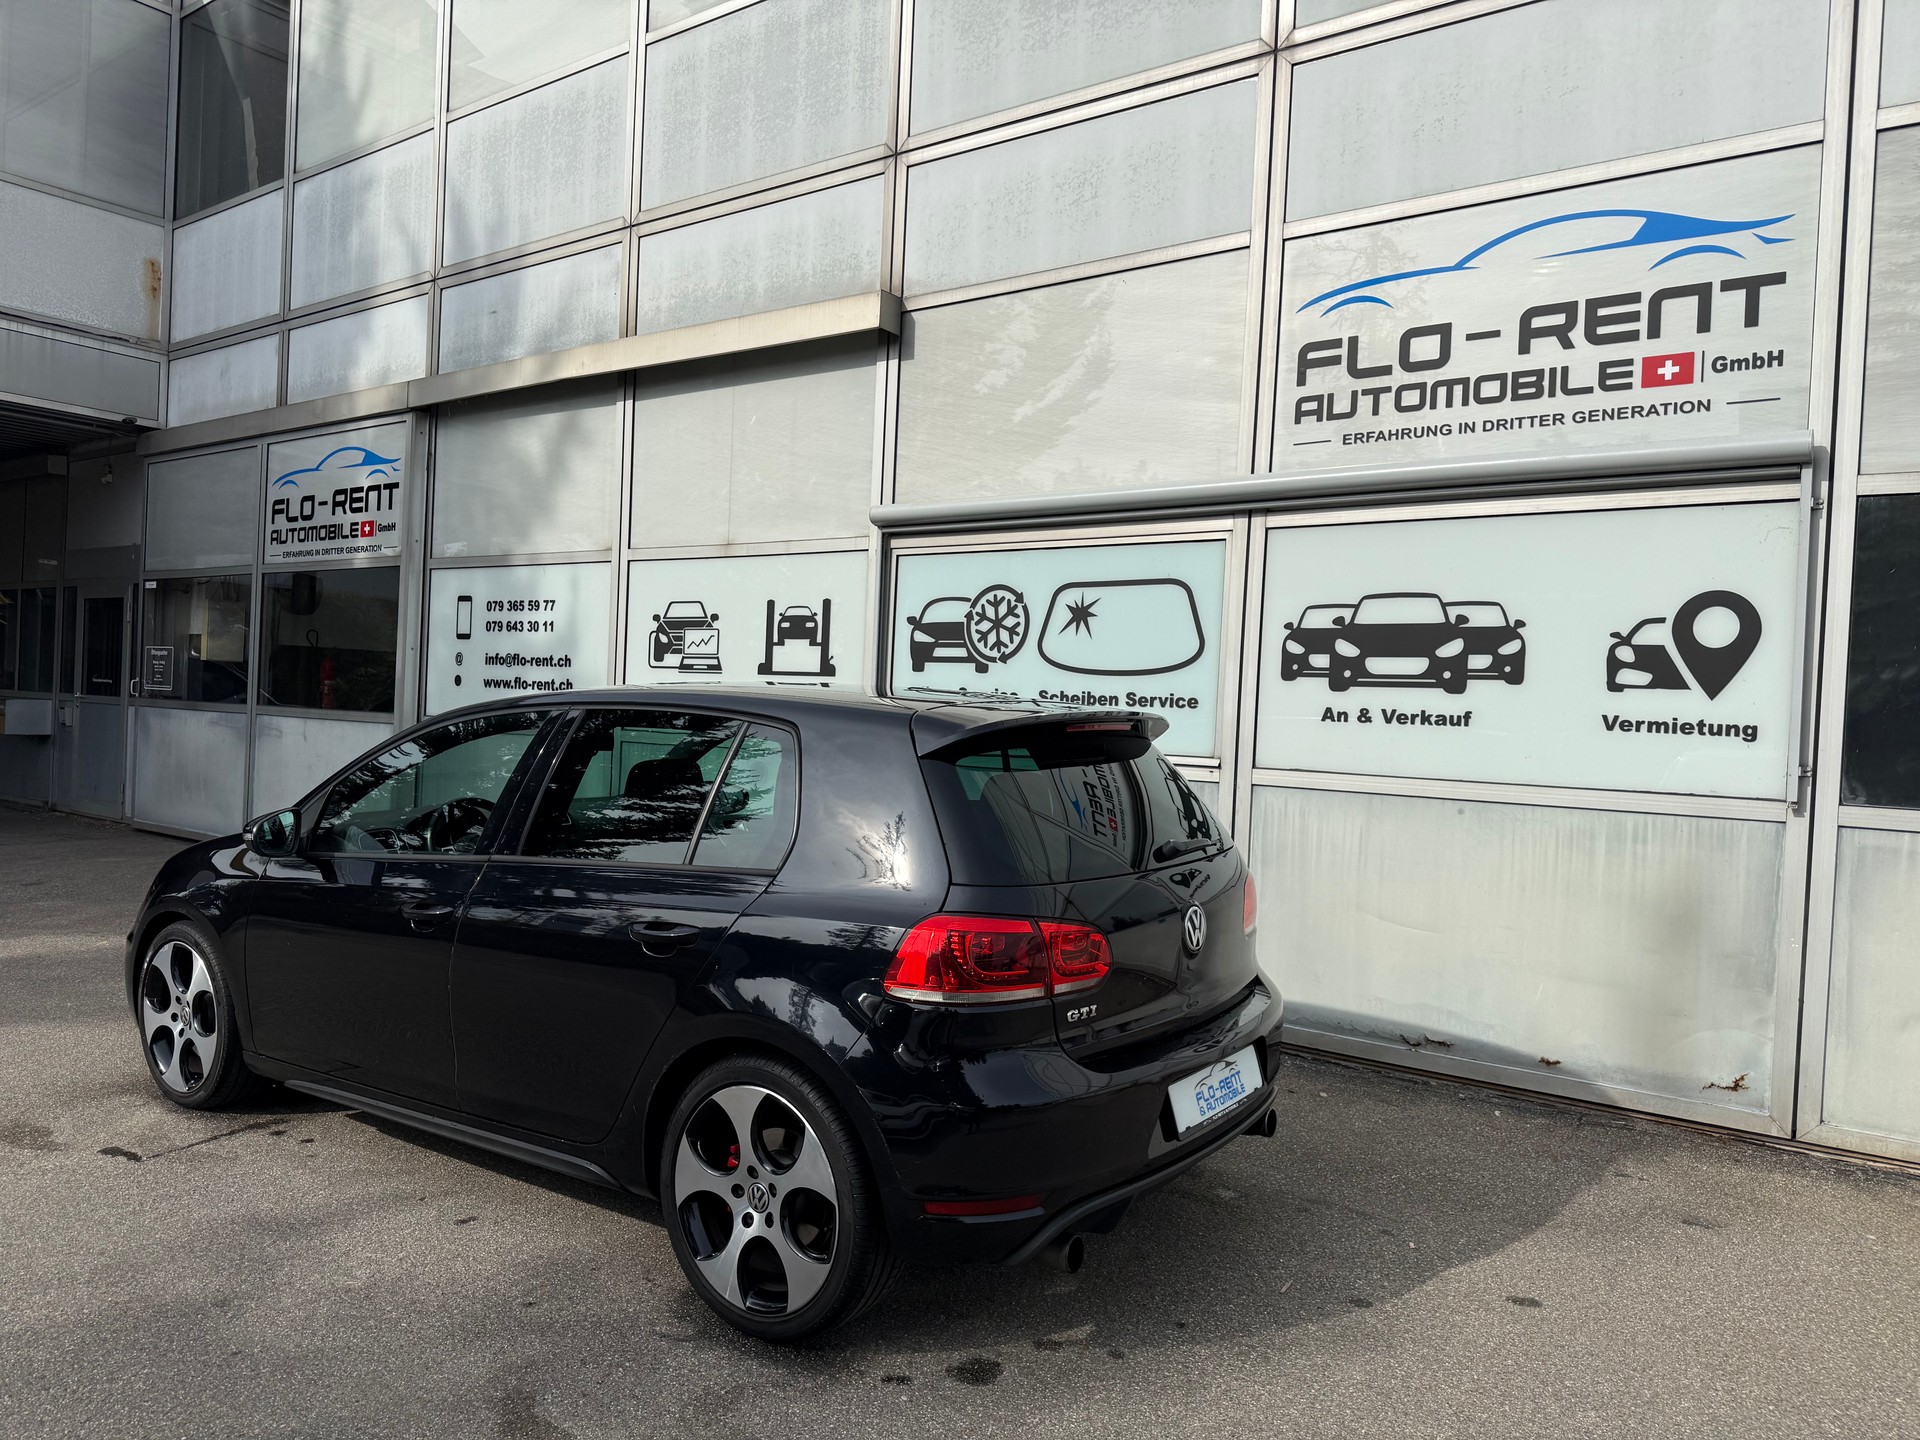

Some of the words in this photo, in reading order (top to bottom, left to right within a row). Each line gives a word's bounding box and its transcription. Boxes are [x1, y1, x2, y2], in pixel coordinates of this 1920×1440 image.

[1294, 358, 1634, 425] AUTOMOBILE
[1710, 349, 1784, 374] GmbH
[1341, 422, 1453, 446] ERFAHRUNG
[1458, 420, 1476, 435] IN
[1481, 412, 1566, 433] DRITTER
[1571, 398, 1712, 424] GENERATION
[270, 521, 360, 546] AUTOMOBILE
[377, 522, 396, 533] GmbH
[282, 549, 314, 558] ERFAHRUNG
[315, 548, 320, 557] IN
[321, 546, 344, 556] DRITTER
[345, 544, 382, 554] GENERATION
[486, 600, 504, 612] 079
[506, 600, 525, 612] 365
[527, 599, 540, 612] 59
[543, 599, 556, 612] 77
[485, 621, 503, 632] 079
[506, 621, 524, 632] 643
[527, 620, 540, 632] 30
[542, 620, 554, 632] 11
[484, 653, 571, 668] info@flo-rent.ch
[483, 676, 573, 691] www.flo-rent.ch
[1125, 691, 1199, 709] Service
[1321, 707, 1348, 723] An
[1356, 708, 1373, 724] &
[1381, 708, 1472, 728] Verkauf
[1601, 714, 1758, 743] Vermietung
[1066, 1004, 1098, 1023] GTI
[1195, 1070, 1242, 1107] FLO-RENT
[1207, 1083, 1246, 1113] AUTOMOBILE
